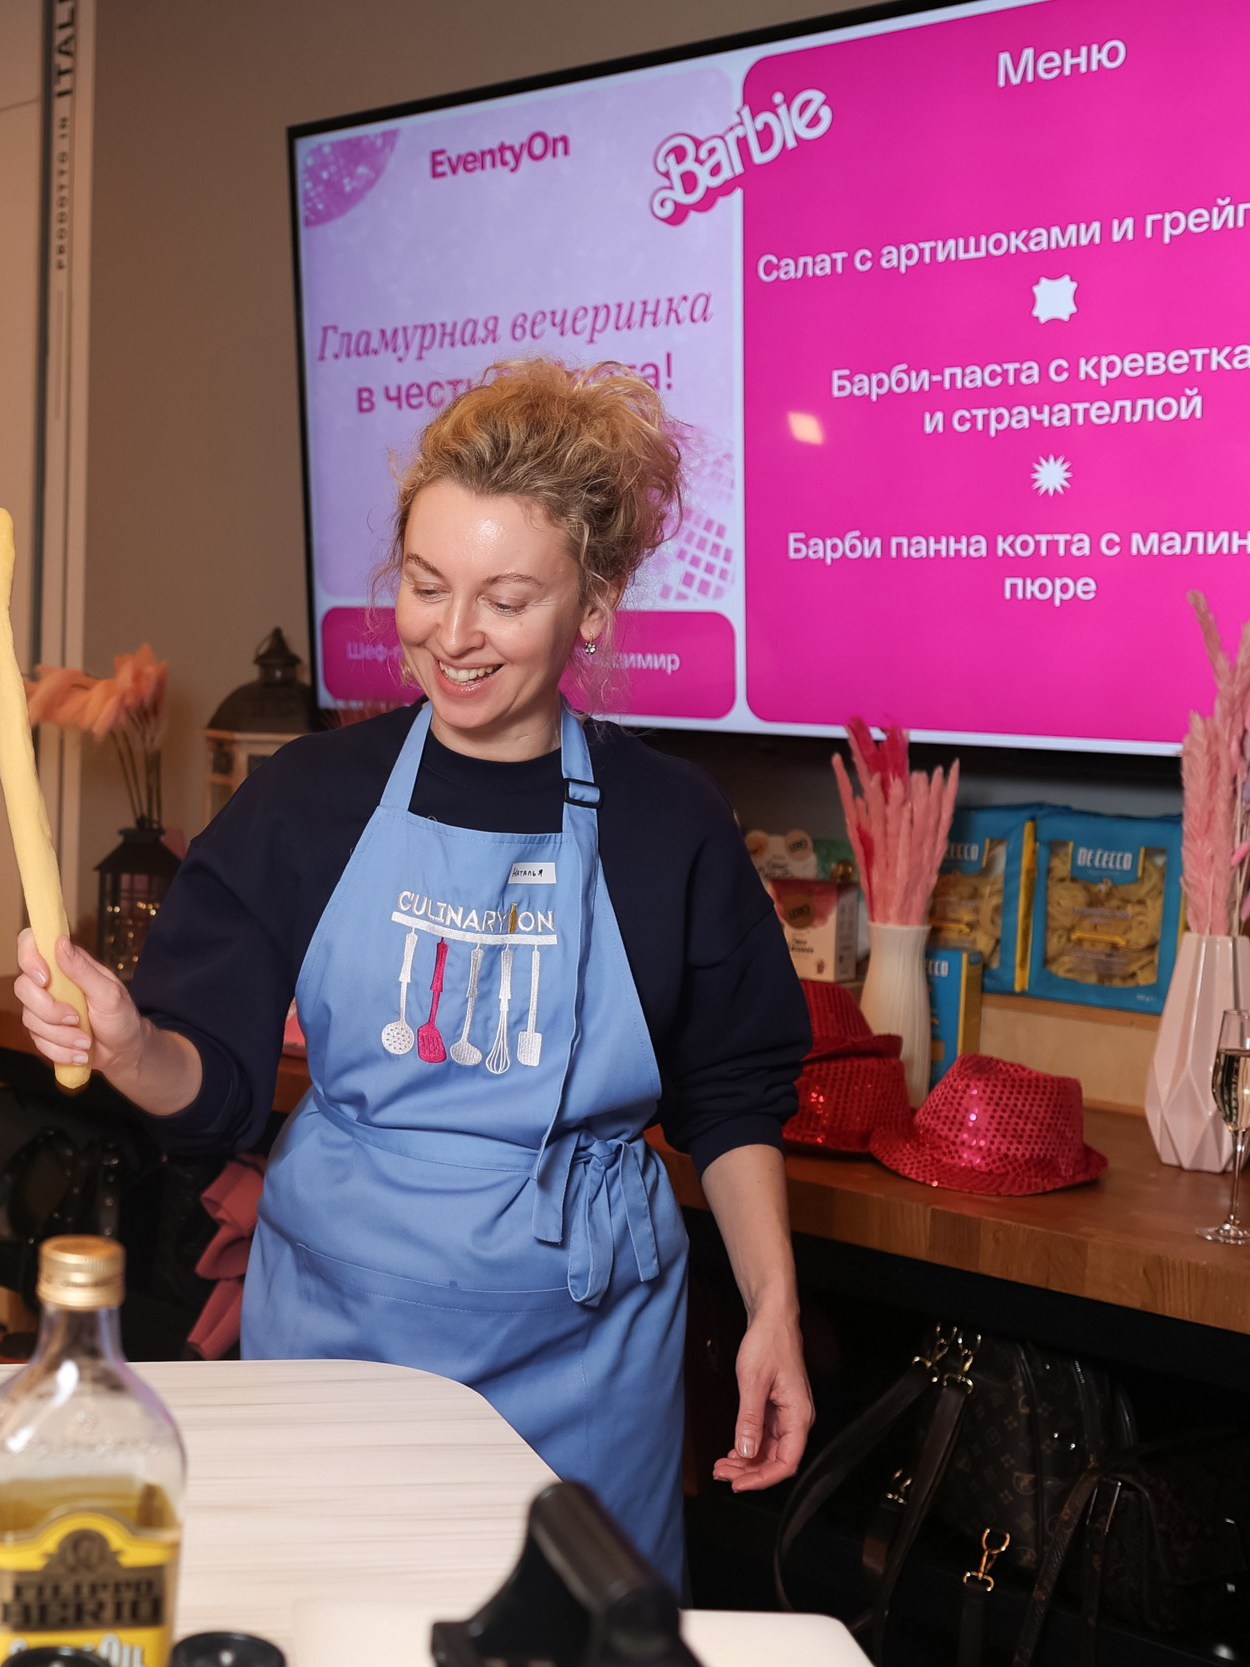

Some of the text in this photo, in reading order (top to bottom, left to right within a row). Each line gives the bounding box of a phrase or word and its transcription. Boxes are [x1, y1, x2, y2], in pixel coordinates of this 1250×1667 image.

[56, 0, 76, 98] ITAL
[997, 39, 1127, 87] Меню
[429, 131, 570, 178] EventyOn
[652, 88, 833, 220] Barbie
[756, 251, 848, 283] Салат
[854, 247, 872, 271] с
[880, 219, 1101, 273] артишоками
[1112, 217, 1134, 242] и
[317, 291, 713, 363] Гламурная вечеринка
[831, 344, 1250, 401] Барби-паста с креветка
[357, 386, 376, 413] в
[924, 388, 1203, 437] и страчателлой
[787, 529, 1250, 565] Барби панна котта с малин
[1004, 575, 1097, 606] пюре
[399, 891, 555, 932] CULINARY ON
